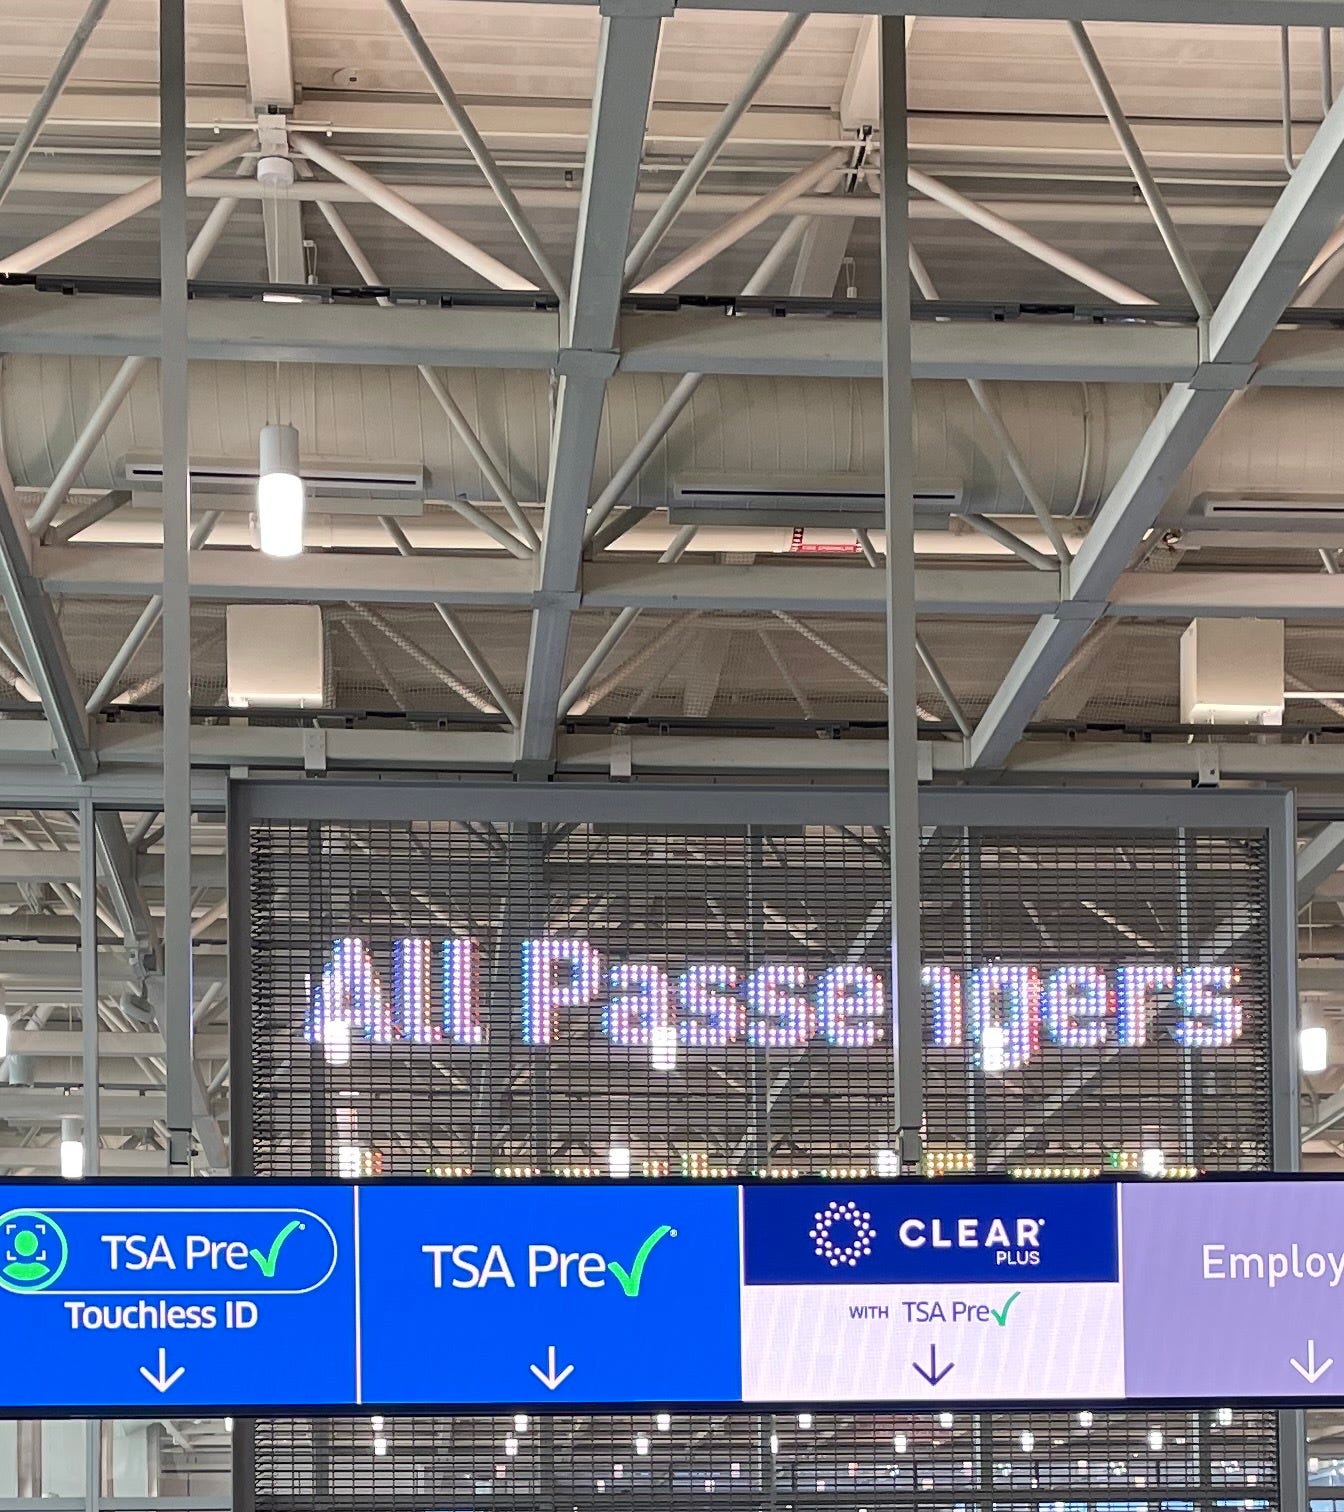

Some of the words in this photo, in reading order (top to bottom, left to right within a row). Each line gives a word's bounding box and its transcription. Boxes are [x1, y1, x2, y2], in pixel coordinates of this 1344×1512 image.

[304, 936, 484, 1044] All
[520, 936, 1242, 1071] Passengers
[900, 1218, 1040, 1248] CLEAR
[102, 1234, 176, 1272] TSA
[186, 1234, 248, 1272] Pre
[423, 1245, 513, 1288] TSA
[529, 1245, 606, 1288] Pre
[996, 1251, 1040, 1265] PLUS
[64, 1300, 216, 1331] Touchless
[226, 1301, 258, 1329] ID
[849, 1305, 888, 1320] WITH
[902, 1301, 946, 1322] TSA
[952, 1301, 990, 1322] Pre
